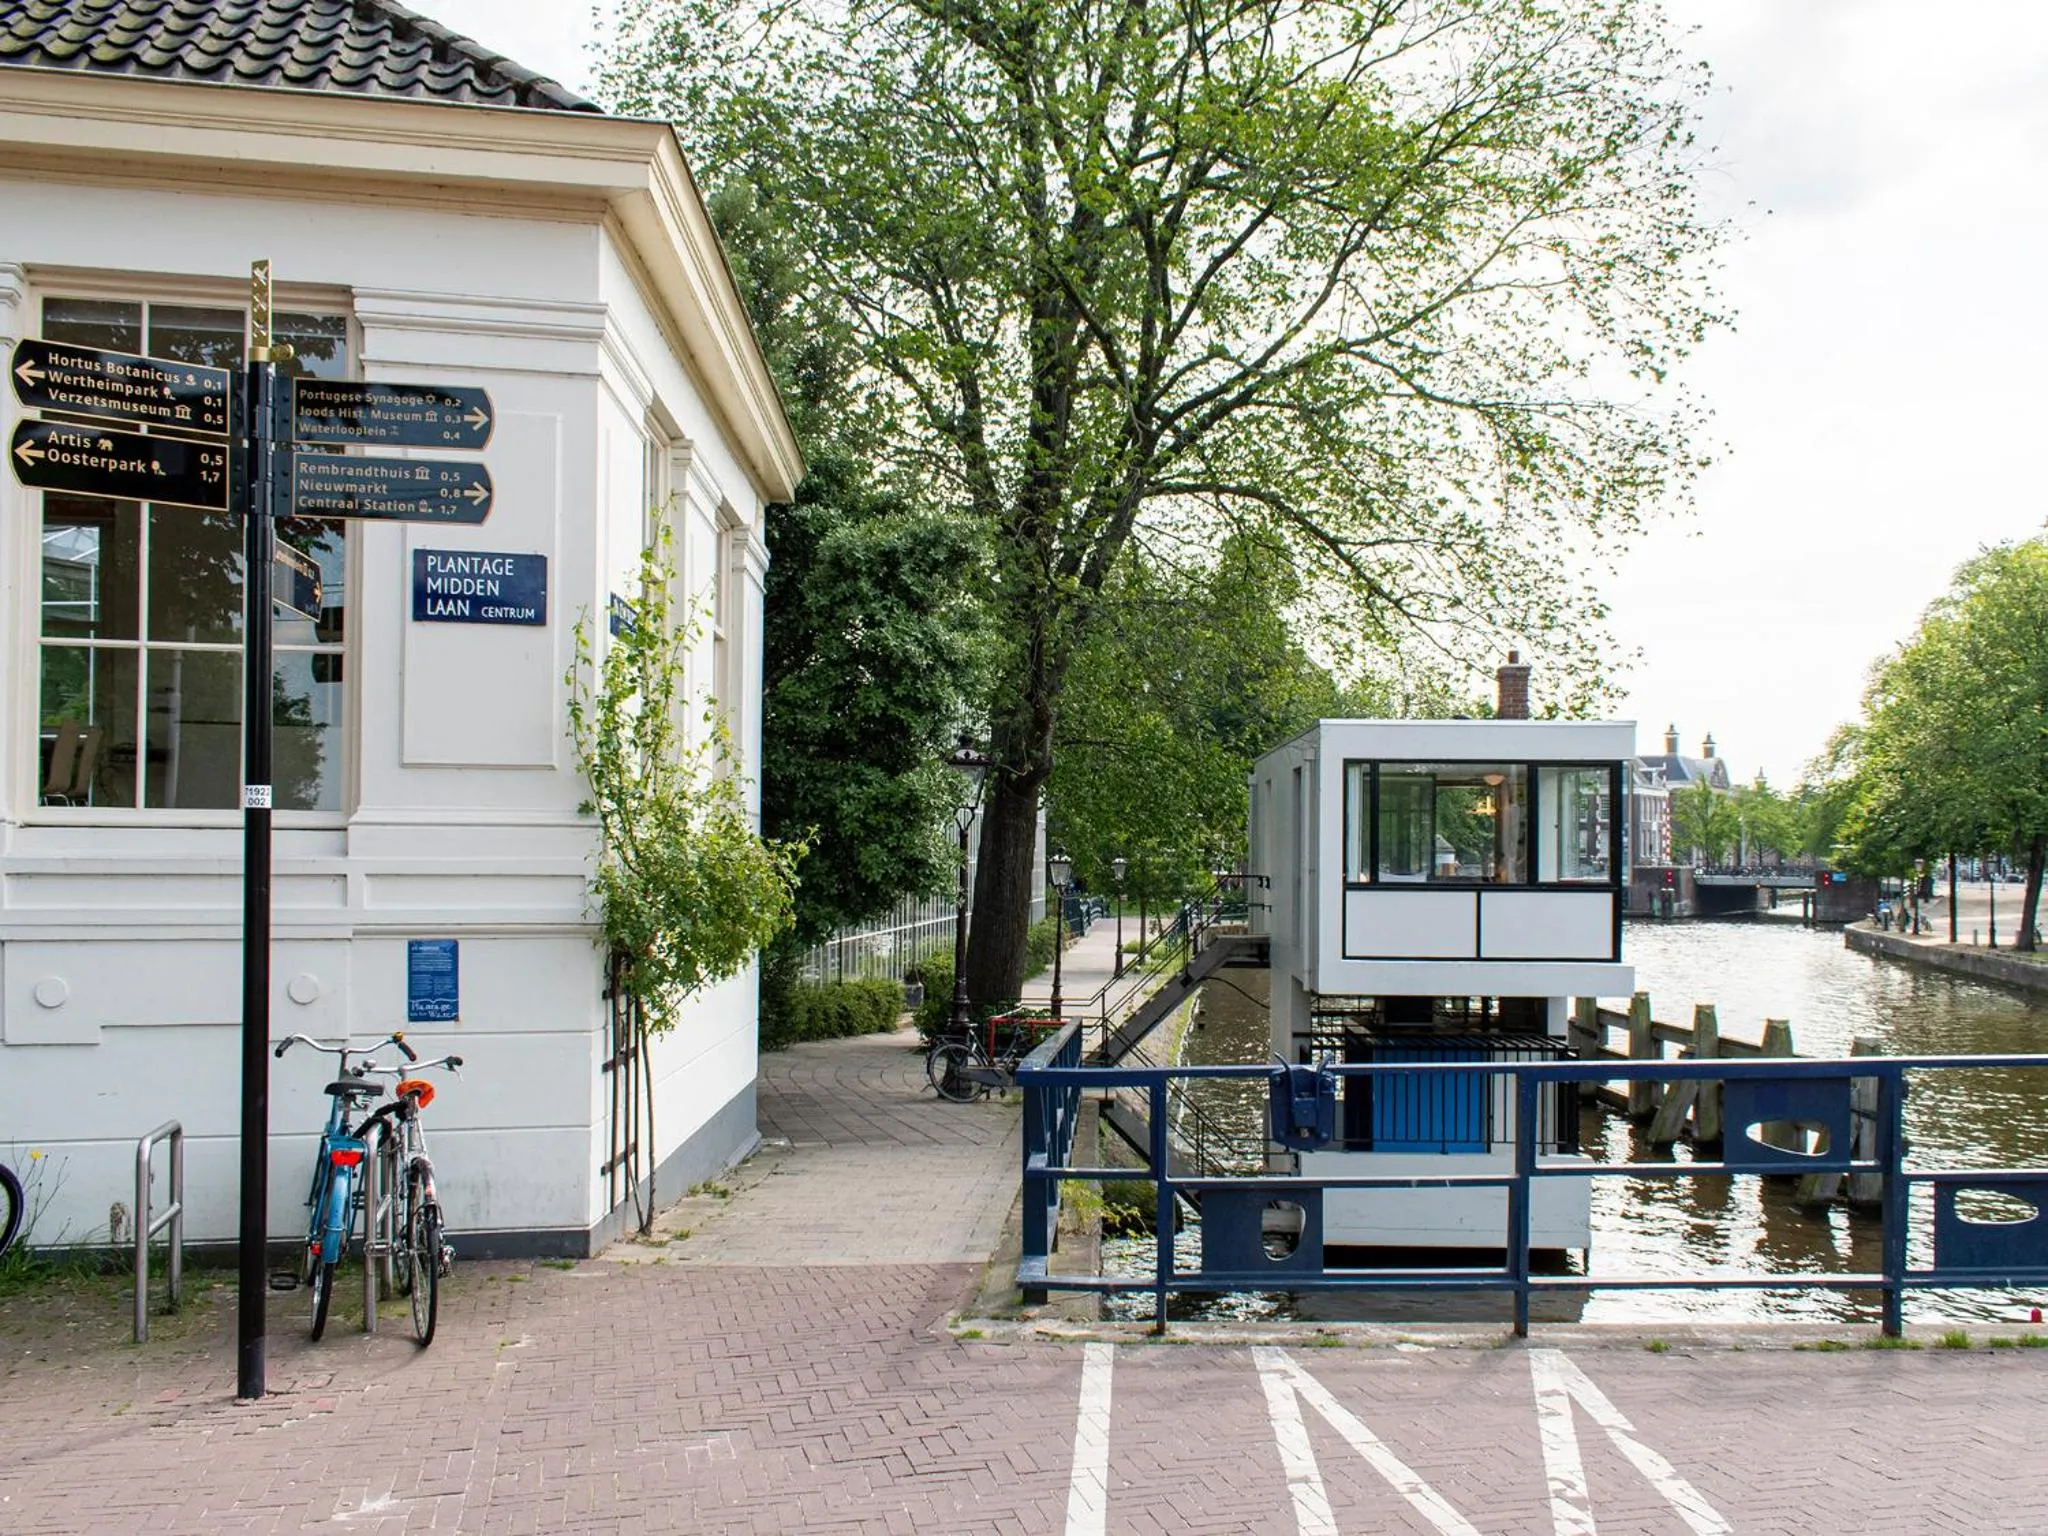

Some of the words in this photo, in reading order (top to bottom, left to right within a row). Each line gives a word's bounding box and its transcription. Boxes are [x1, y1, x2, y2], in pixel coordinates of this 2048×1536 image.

[48, 352, 101, 372] Hortus
[107, 362, 180, 384] Botanicus
[48, 370, 159, 399] Wertheimpark
[48, 387, 171, 417] Verzetsmuseum
[300, 389, 361, 403] Portugese
[365, 392, 424, 407] Synagoge
[299, 406, 335, 418] Joods
[339, 408, 366, 419] Hist.
[371, 410, 422, 421] Museum
[300, 423, 386, 437] Waterlooplein
[48, 431, 91, 449] Artis
[48, 448, 147, 474] Oosterpark
[300, 462, 411, 480] Rembrandthuis
[300, 480, 388, 495] Nieuwmarkt
[299, 498, 359, 511] Centraal
[363, 500, 415, 513] Station
[426, 555, 514, 576] PLANTAGE
[426, 577, 500, 597] MIDDEN
[426, 598, 470, 617] LAAN
[481, 606, 535, 620] CENTRUM
